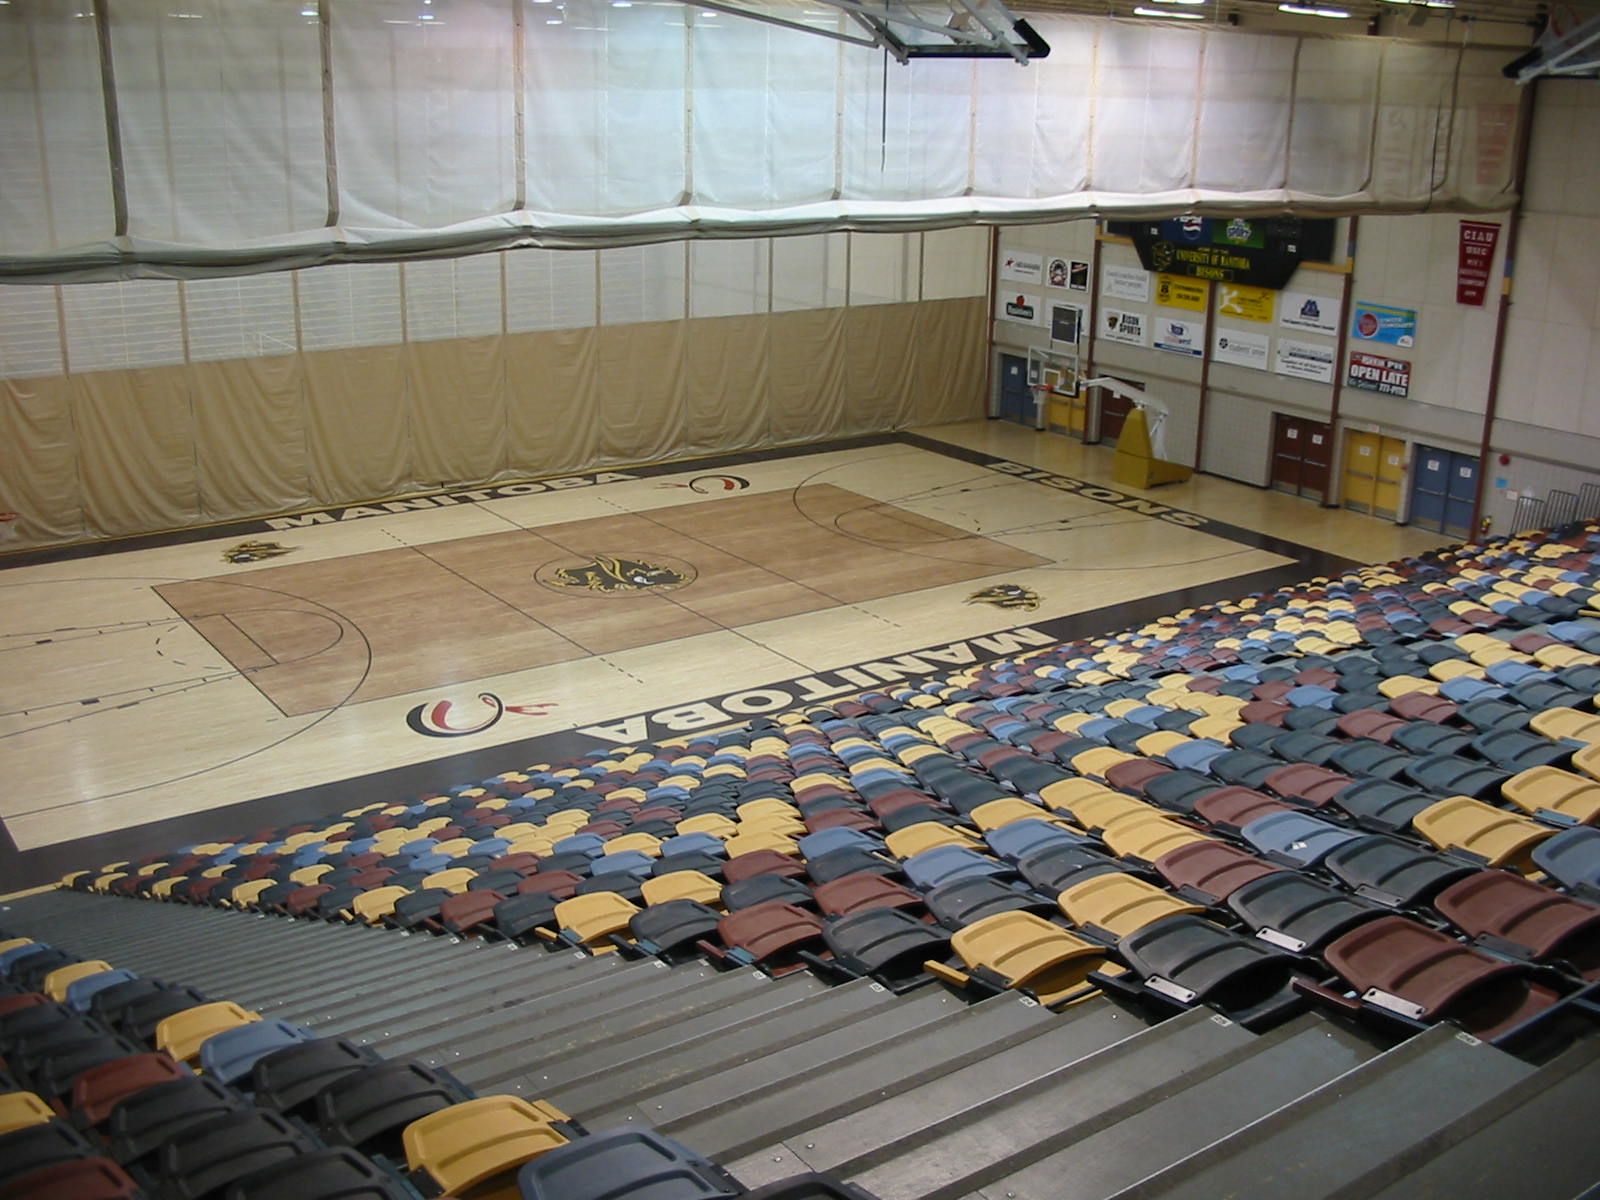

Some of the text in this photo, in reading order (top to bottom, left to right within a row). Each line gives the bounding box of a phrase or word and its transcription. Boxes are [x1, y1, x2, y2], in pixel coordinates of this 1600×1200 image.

[1176, 249, 1209, 264] UNIVERSITY
[1211, 254, 1219, 265] OF
[1119, 323, 1141, 336] SPORTS
[1350, 364, 1380, 381] OPEN
[1382, 370, 1408, 386] LATE
[265, 472, 642, 530] MANITOBA
[986, 461, 1209, 526] BISONS
[576, 627, 1059, 744] MANITOBA
